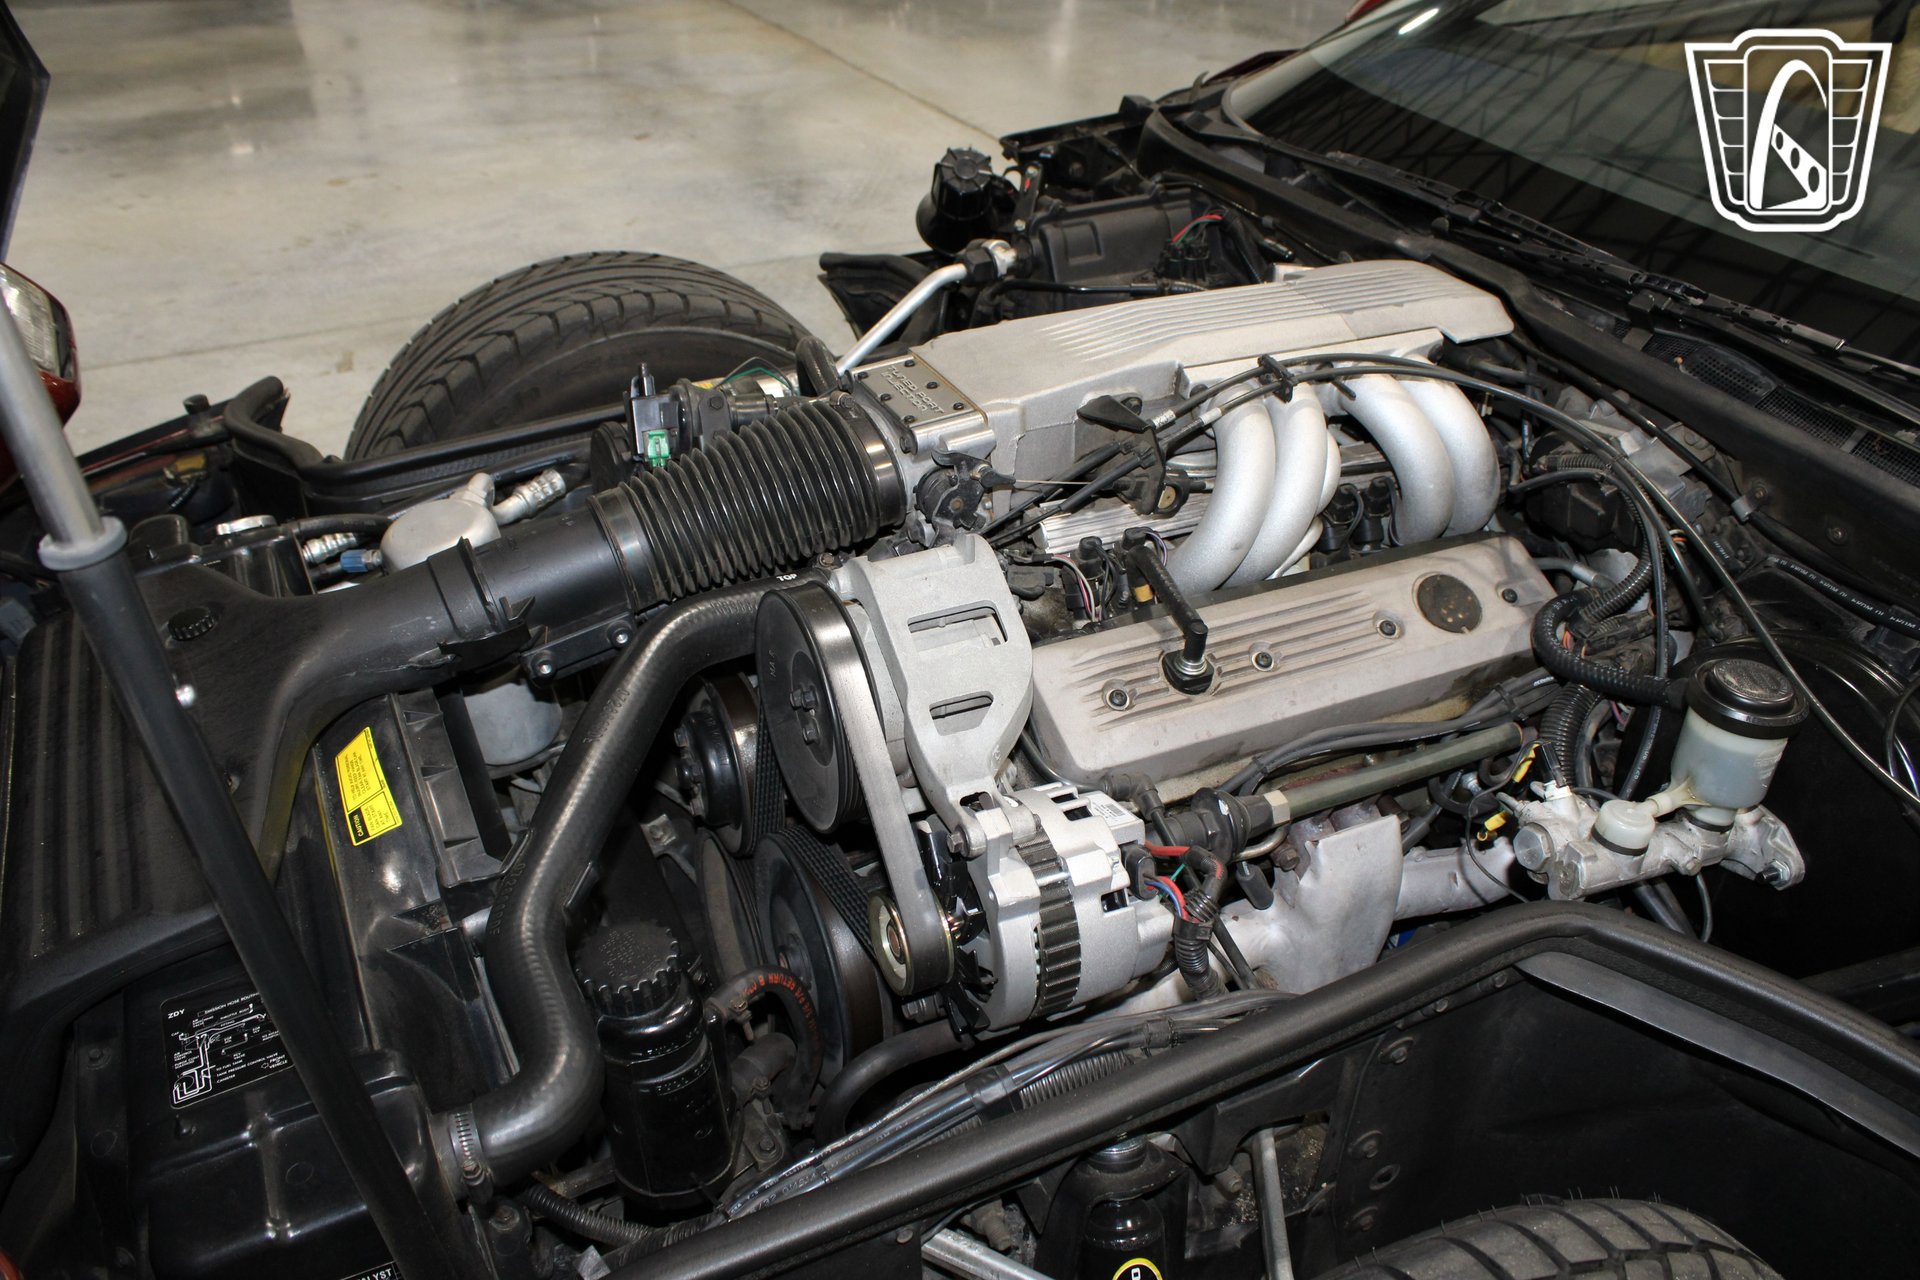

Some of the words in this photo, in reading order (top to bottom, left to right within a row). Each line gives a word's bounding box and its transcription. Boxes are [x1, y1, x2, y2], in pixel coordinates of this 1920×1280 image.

[881, 371, 928, 411] INJECTION
[888, 365, 918, 391] TUNED
[916, 391, 945, 413] PORT
[776, 573, 797, 582] TOP
[353, 815, 364, 837] CAUTION
[768, 973, 795, 990] RETURN
[168, 1009, 185, 1019] ZDY
